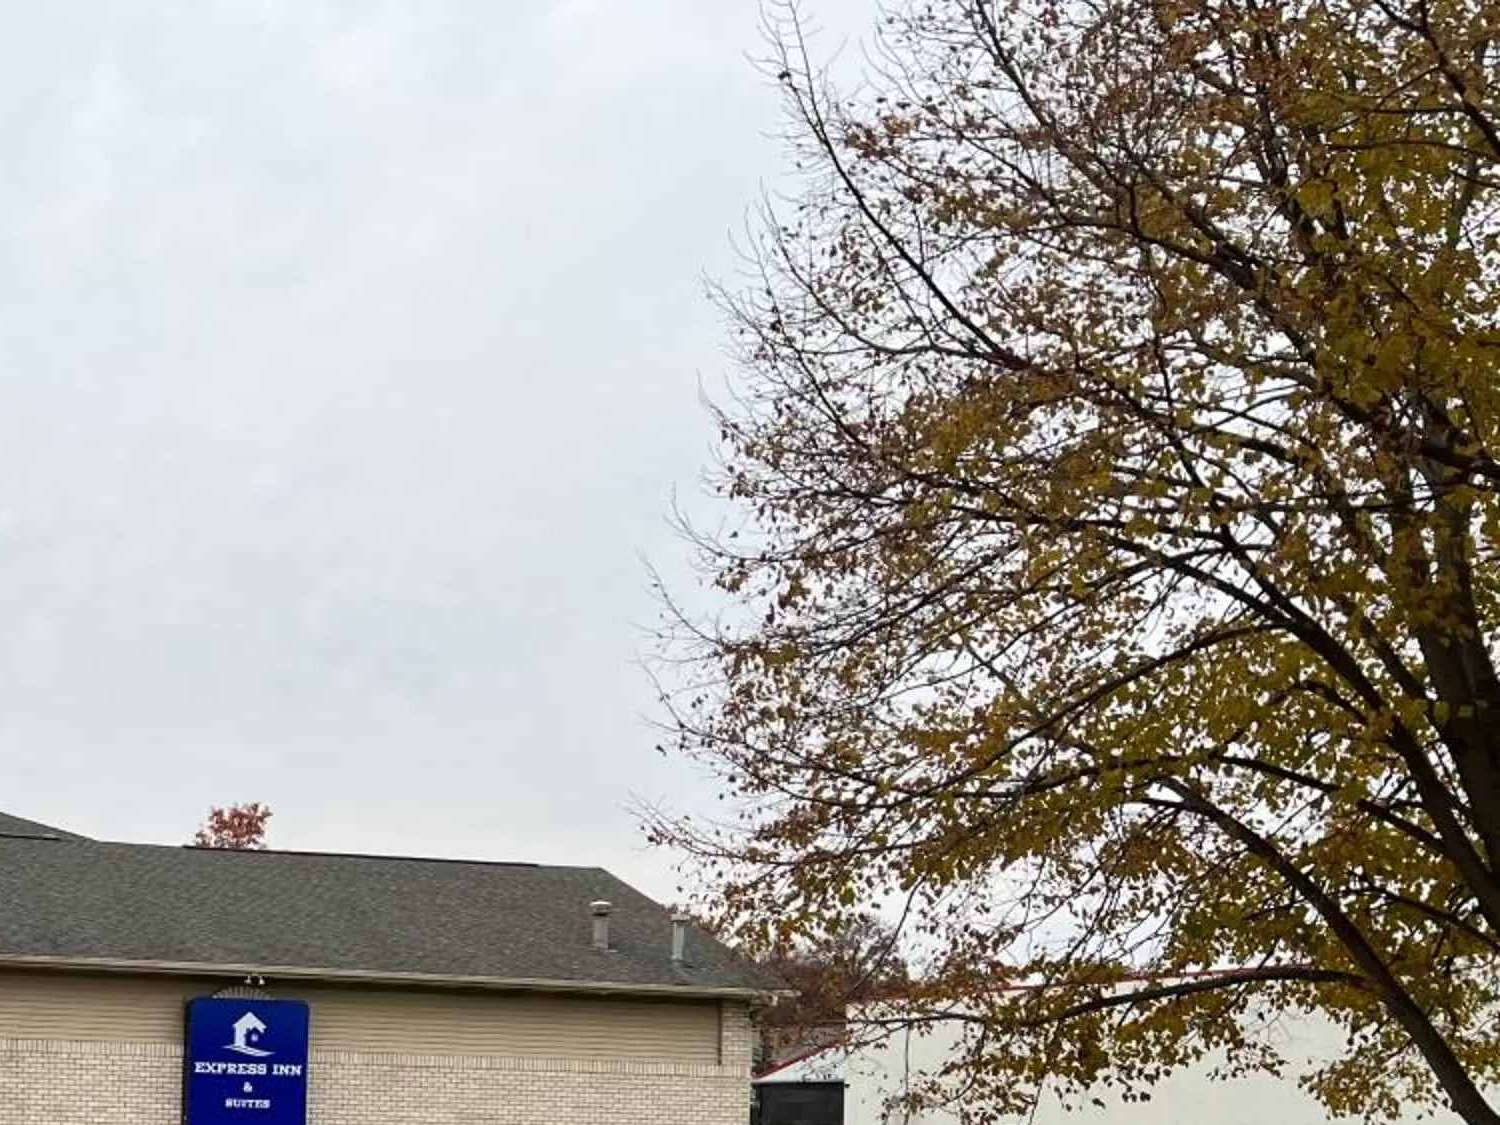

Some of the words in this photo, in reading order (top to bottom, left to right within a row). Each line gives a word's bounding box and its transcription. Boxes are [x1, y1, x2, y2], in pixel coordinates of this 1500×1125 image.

[194, 1061, 267, 1075] EXPRESS
[272, 1063, 302, 1076] INN
[243, 1081, 253, 1093] &
[225, 1098, 270, 1109] SUITES
